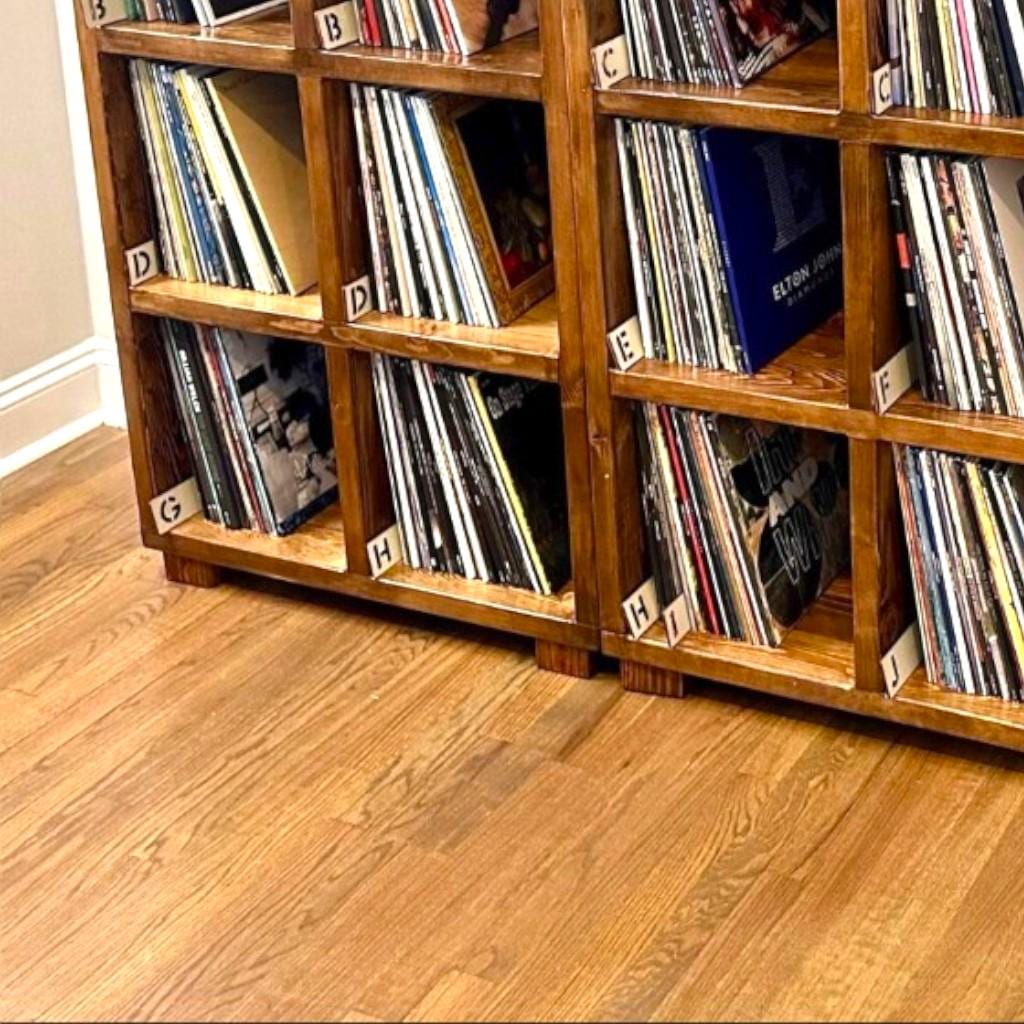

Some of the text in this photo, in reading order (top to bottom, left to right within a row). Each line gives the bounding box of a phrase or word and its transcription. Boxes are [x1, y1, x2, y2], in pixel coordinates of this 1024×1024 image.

[324, 12, 342, 42] B
[602, 48, 617, 78] C
[879, 71, 889, 103] C
[133, 251, 150, 278] D
[772, 242, 842, 302] ELTON JOHN
[351, 284, 367, 315] D
[616, 330, 634, 362] E
[880, 371, 889, 404] F
[160, 496, 181, 523] G
[373, 537, 392, 569] H
[630, 594, 649, 629] H
[890, 655, 899, 687] J
